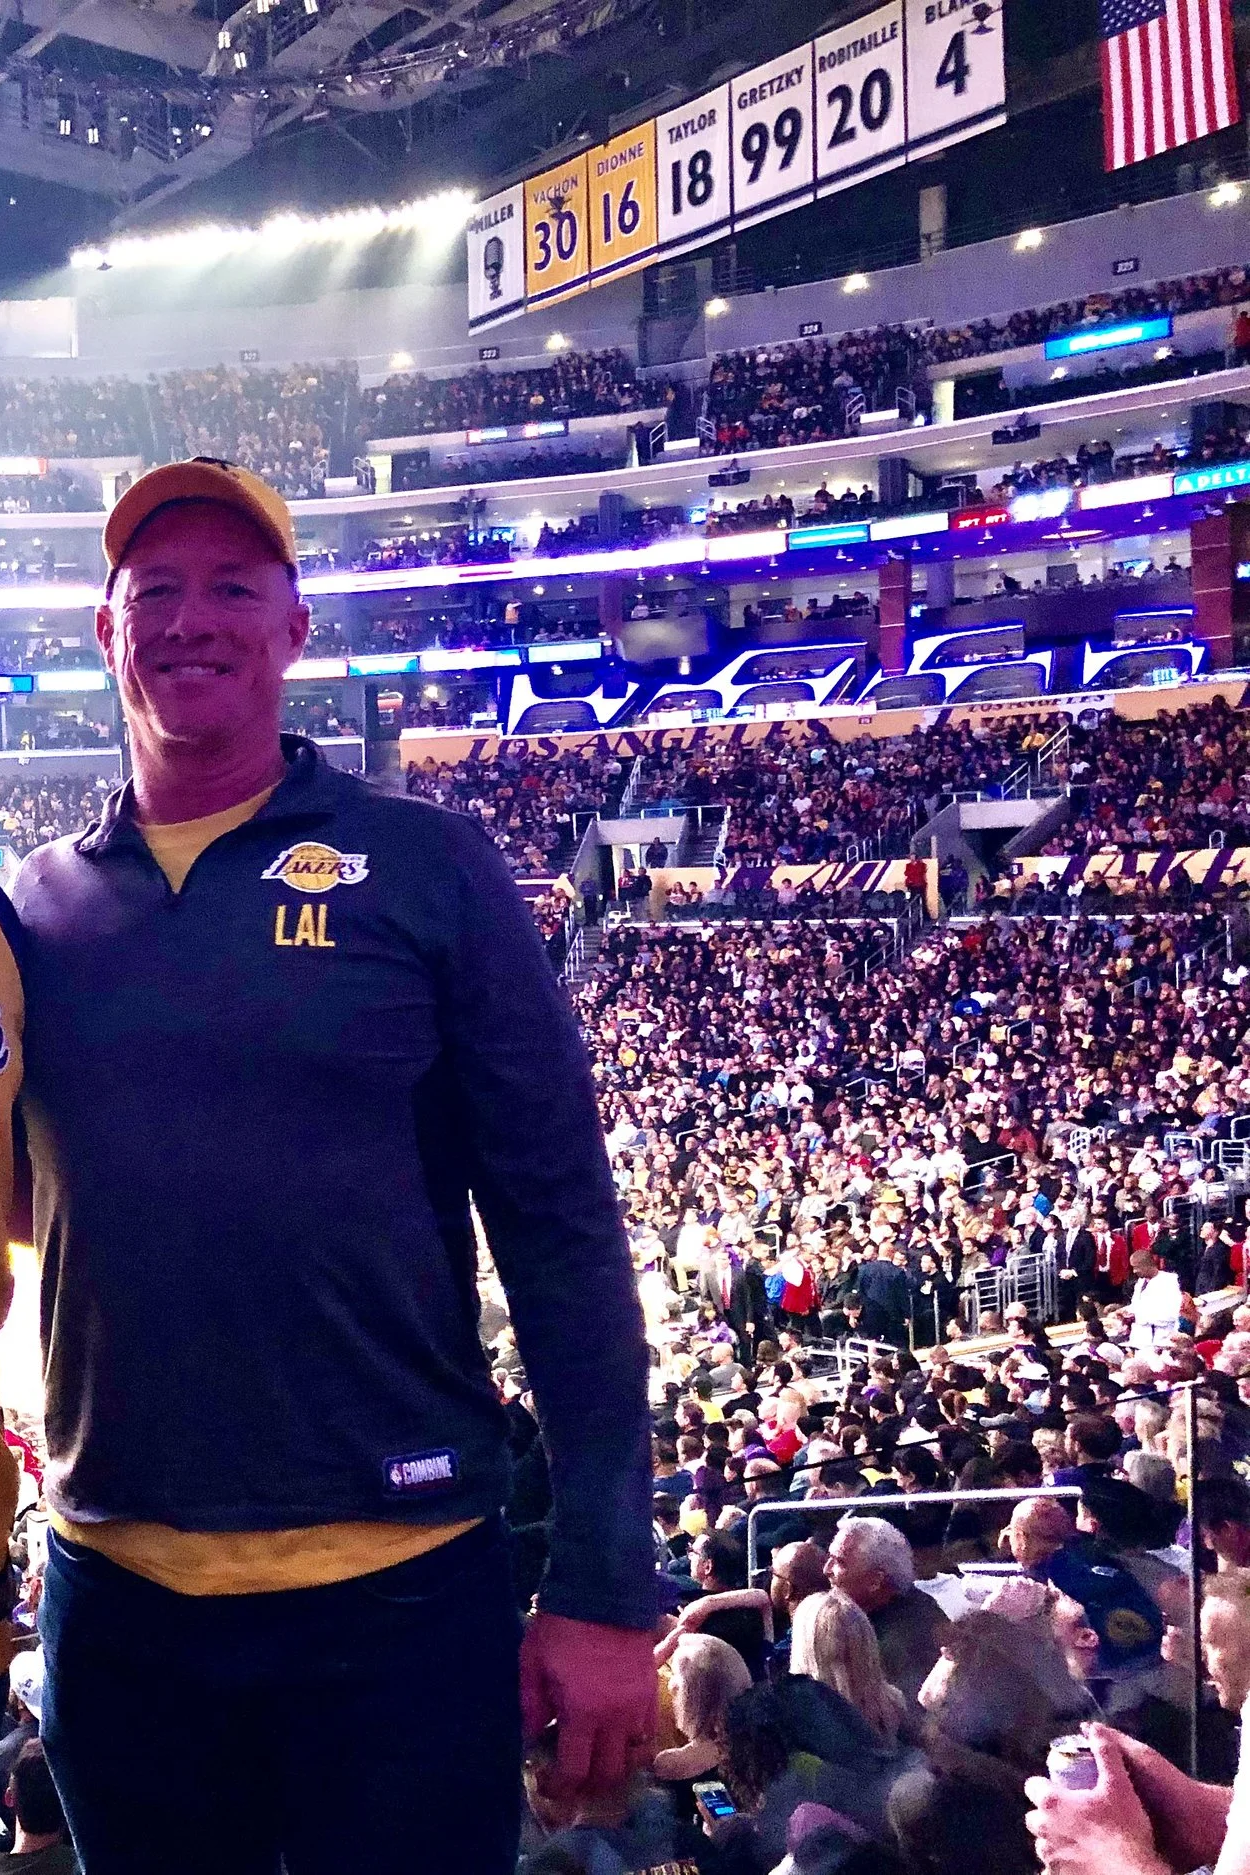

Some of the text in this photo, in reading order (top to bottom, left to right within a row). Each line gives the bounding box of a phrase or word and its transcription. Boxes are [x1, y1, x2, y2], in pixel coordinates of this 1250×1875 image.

[924, 0, 990, 24] BLA
[818, 20, 898, 73] ROBITAILLE
[935, 30, 970, 97] 4
[737, 65, 804, 110] GRETZKY
[826, 67, 893, 150] 20
[667, 108, 717, 145] TAYLOR
[741, 106, 803, 185] 99
[596, 141, 645, 177] DIONNE
[533, 174, 579, 205] VACHON
[671, 149, 714, 216] 18
[475, 203, 515, 234] MILLER
[602, 180, 641, 245] 16
[533, 208, 578, 272] 30
[1197, 467, 1250, 489] DELT
[273, 903, 337, 948] LAL
[402, 1455, 453, 1485] COMBINE
